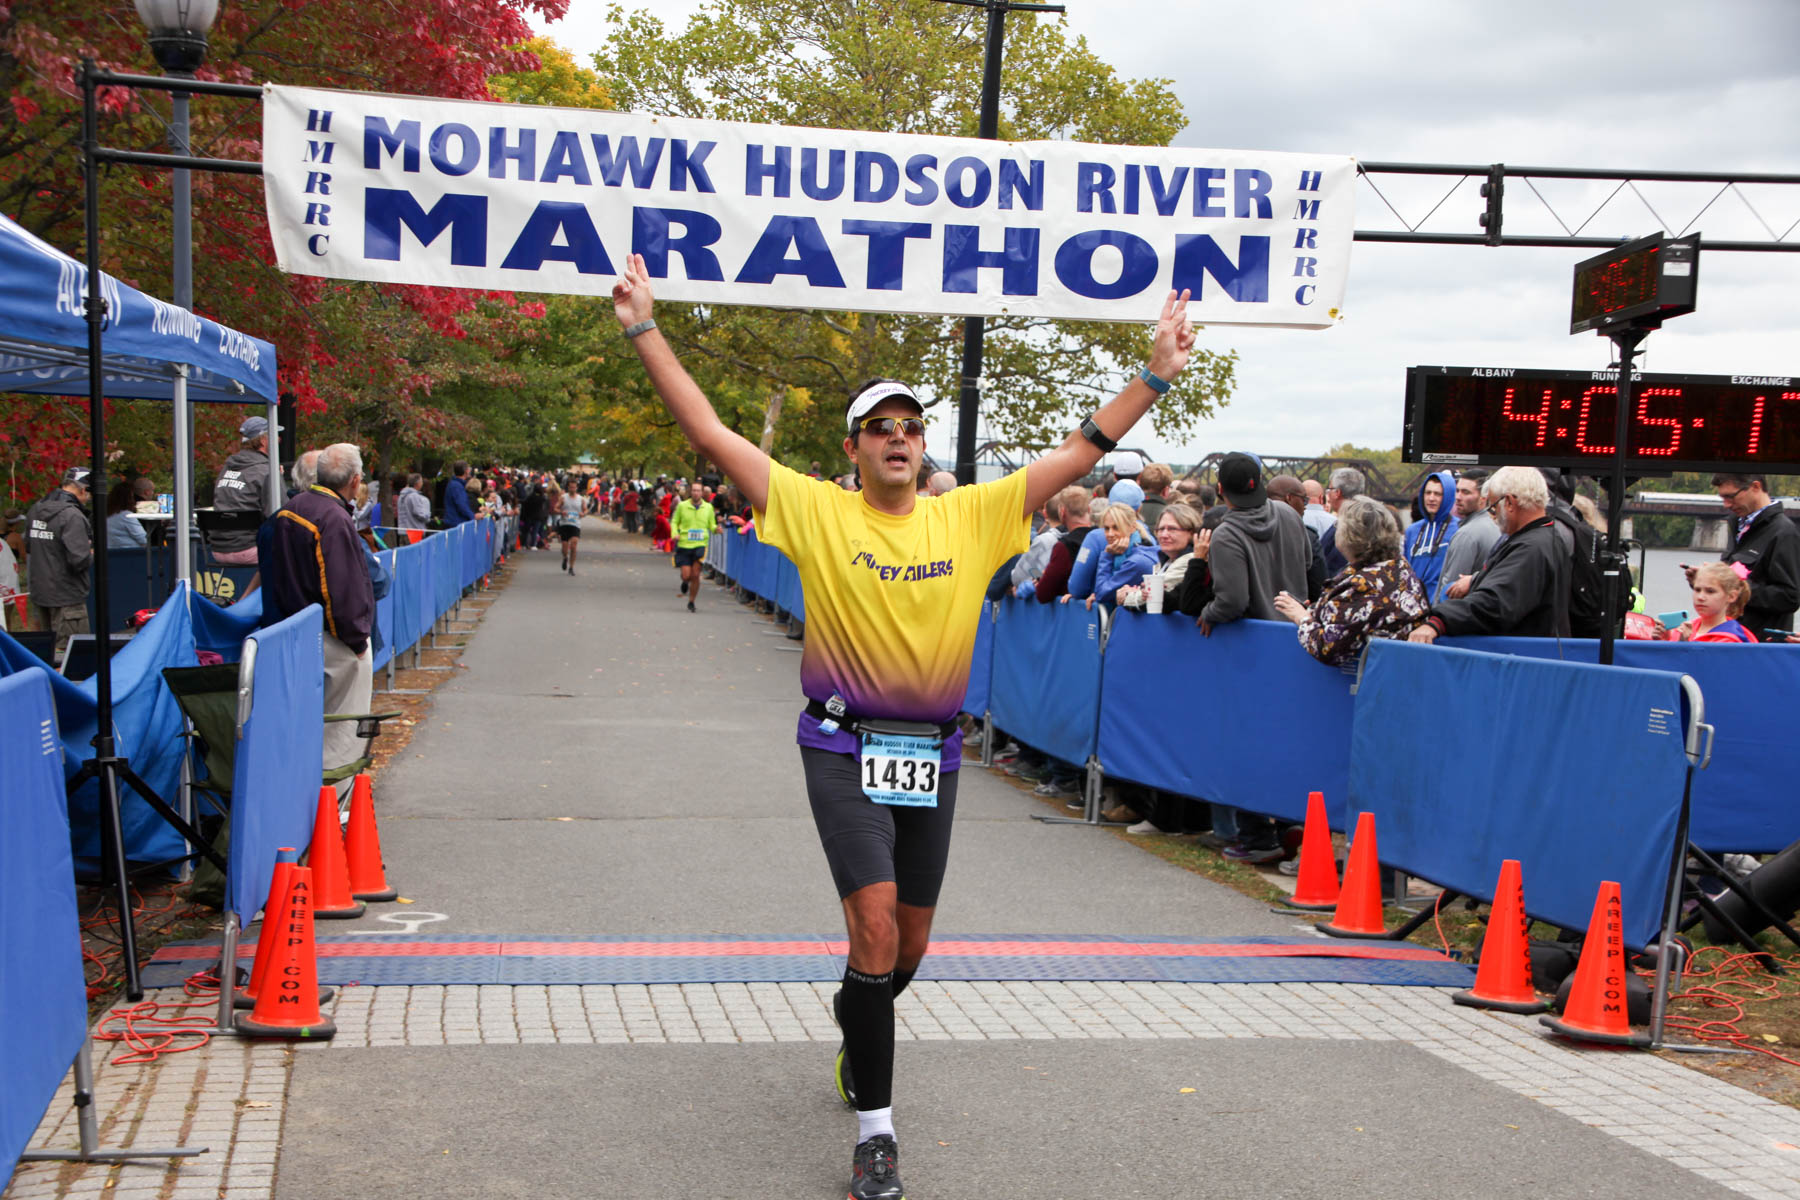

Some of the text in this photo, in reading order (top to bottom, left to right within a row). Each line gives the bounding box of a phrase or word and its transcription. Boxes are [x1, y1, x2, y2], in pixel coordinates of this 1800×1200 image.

[303, 109, 334, 256] HMRRC
[364, 115, 1273, 219] MOHAWK HUDSON RIVER
[363, 186, 1271, 304] MARATHON
[1292, 170, 1322, 306] HMRRC
[1471, 368, 1515, 377] ALBANY
[1731, 375, 1791, 386] EXCHANGE
[866, 757, 936, 792] 1433
[278, 881, 308, 1004] AREEP.COM
[1603, 896, 1620, 1013] AREEP.COM
